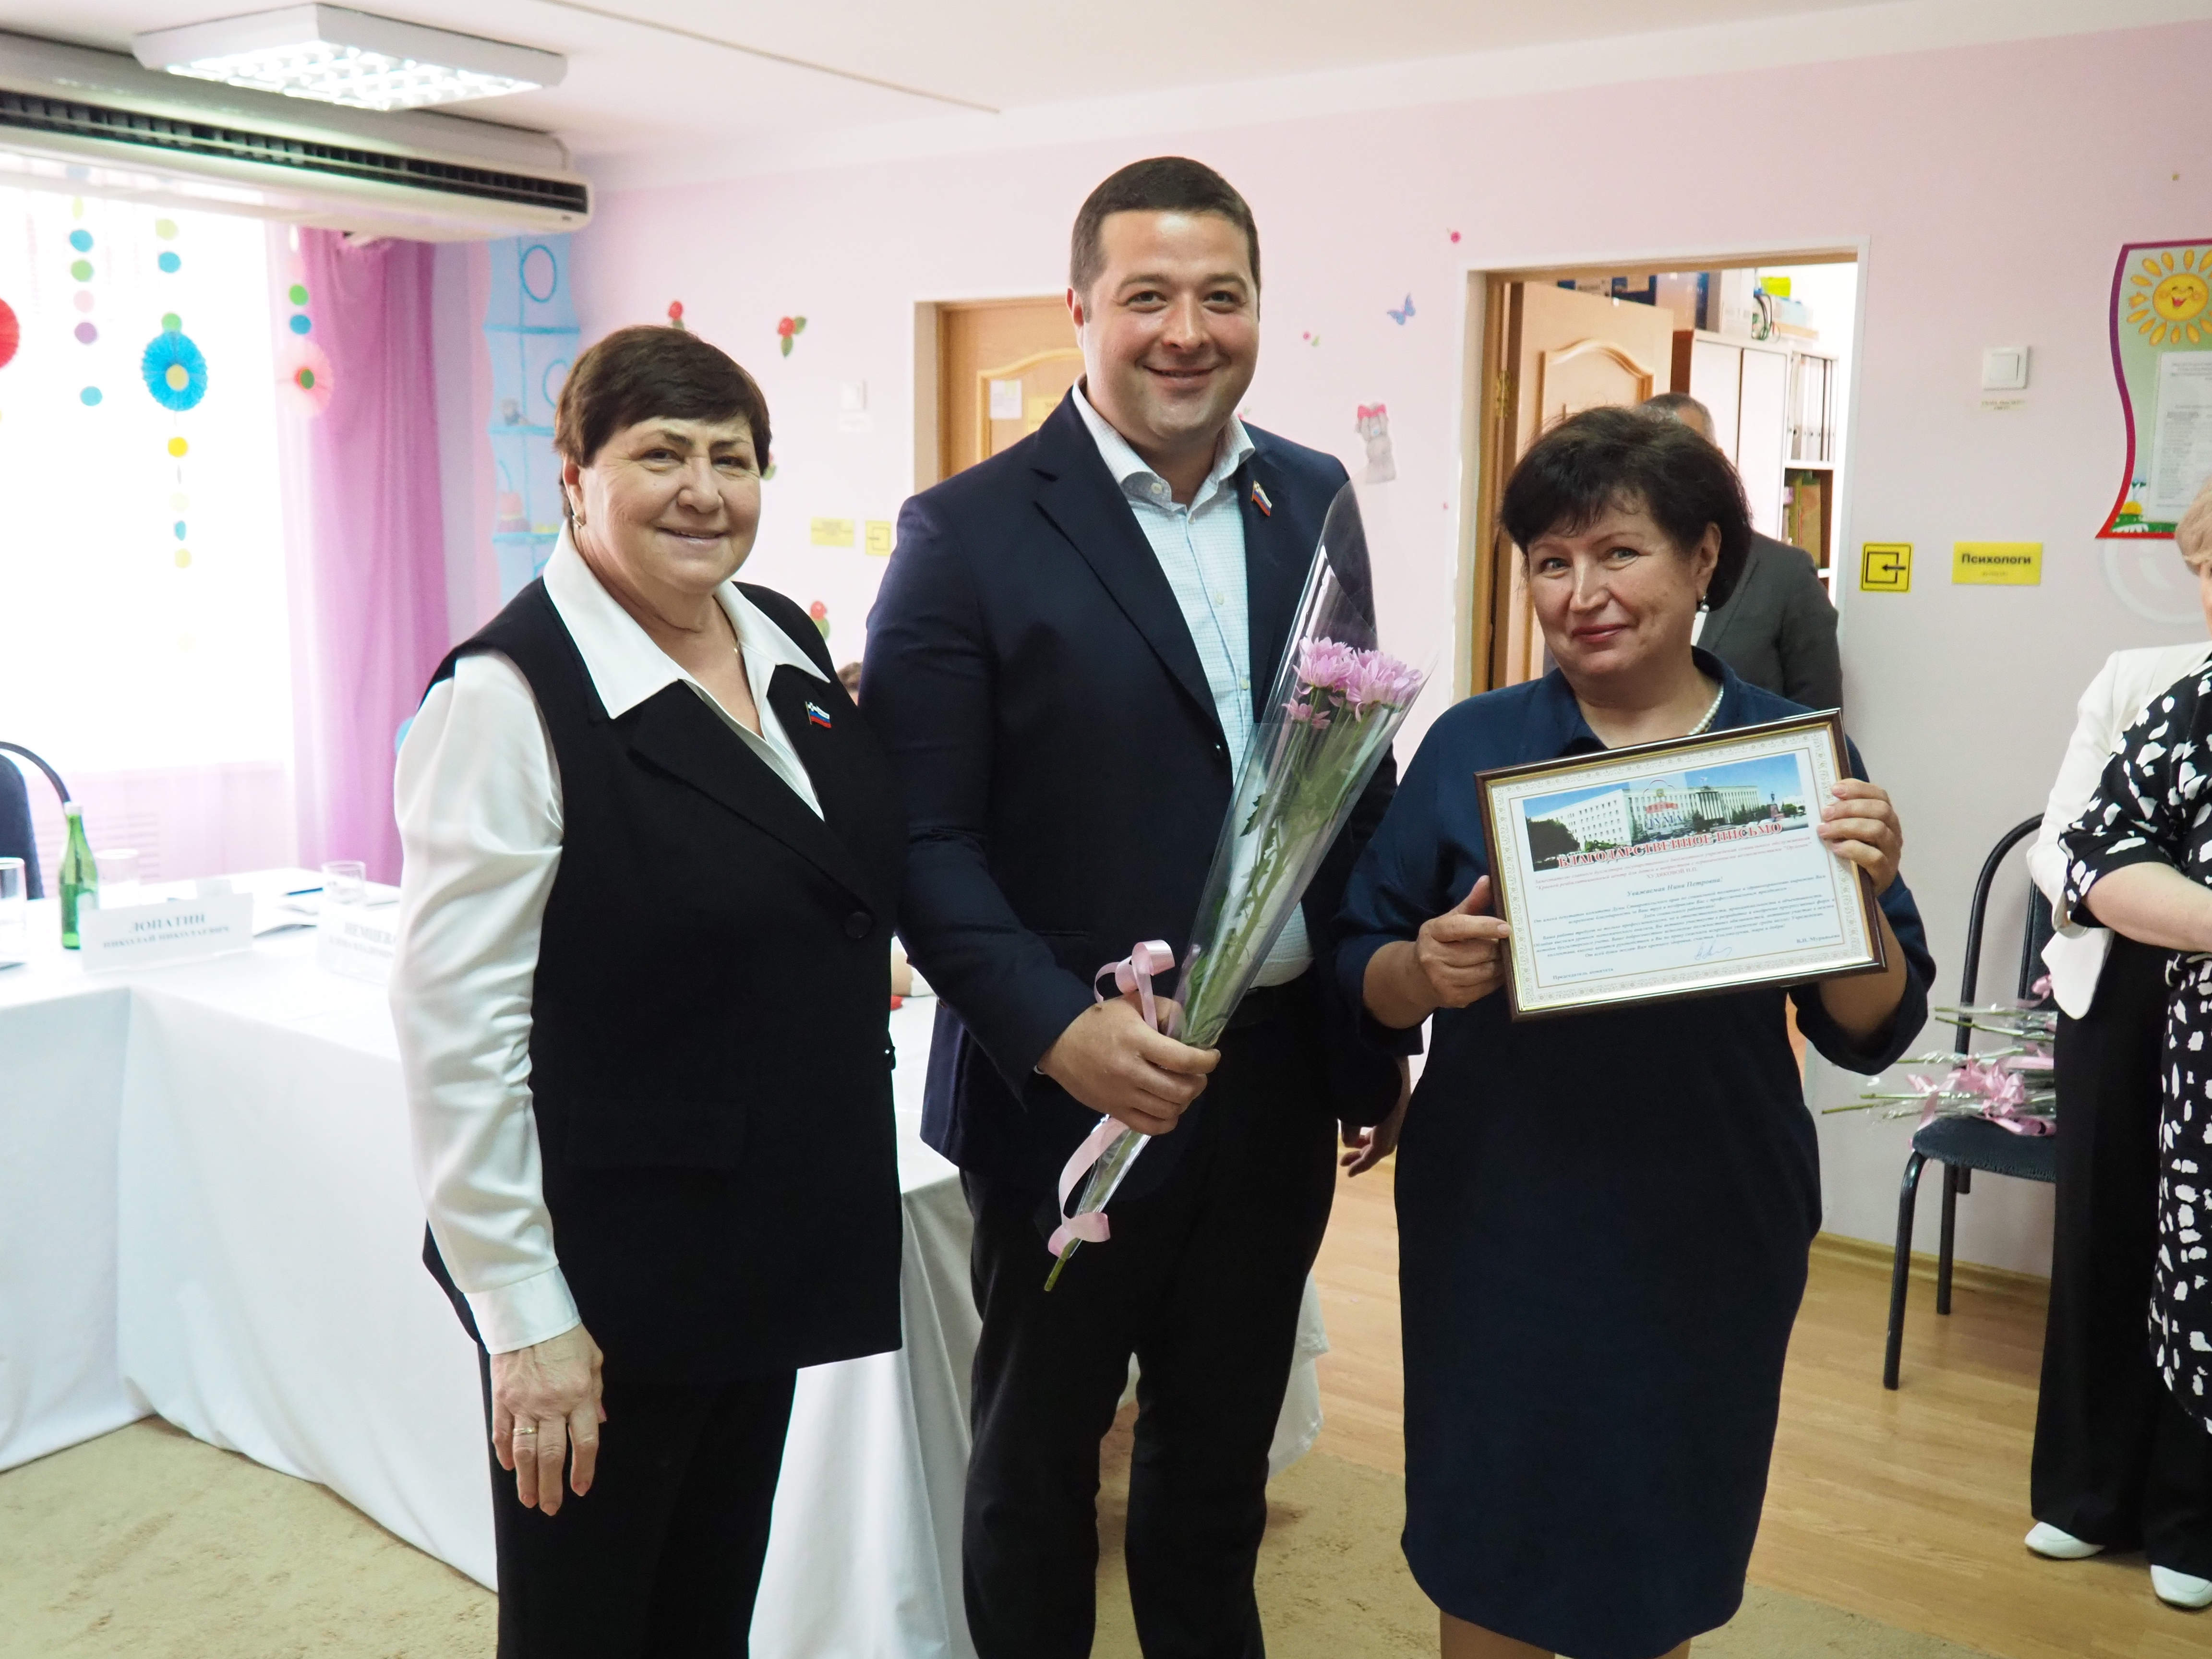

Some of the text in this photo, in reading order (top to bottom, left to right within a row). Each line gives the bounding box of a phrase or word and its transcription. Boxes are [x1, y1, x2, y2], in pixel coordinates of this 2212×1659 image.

[1961, 553, 2031, 565] Психологи
[1557, 821, 1783, 868] БЛАГОДАРСТВЕННОЕ ПИСЬМО
[1626, 887, 1665, 896] Уважаемая
[1686, 876, 1723, 887] Петровна!
[129, 914, 205, 933] ЛОПАТИН
